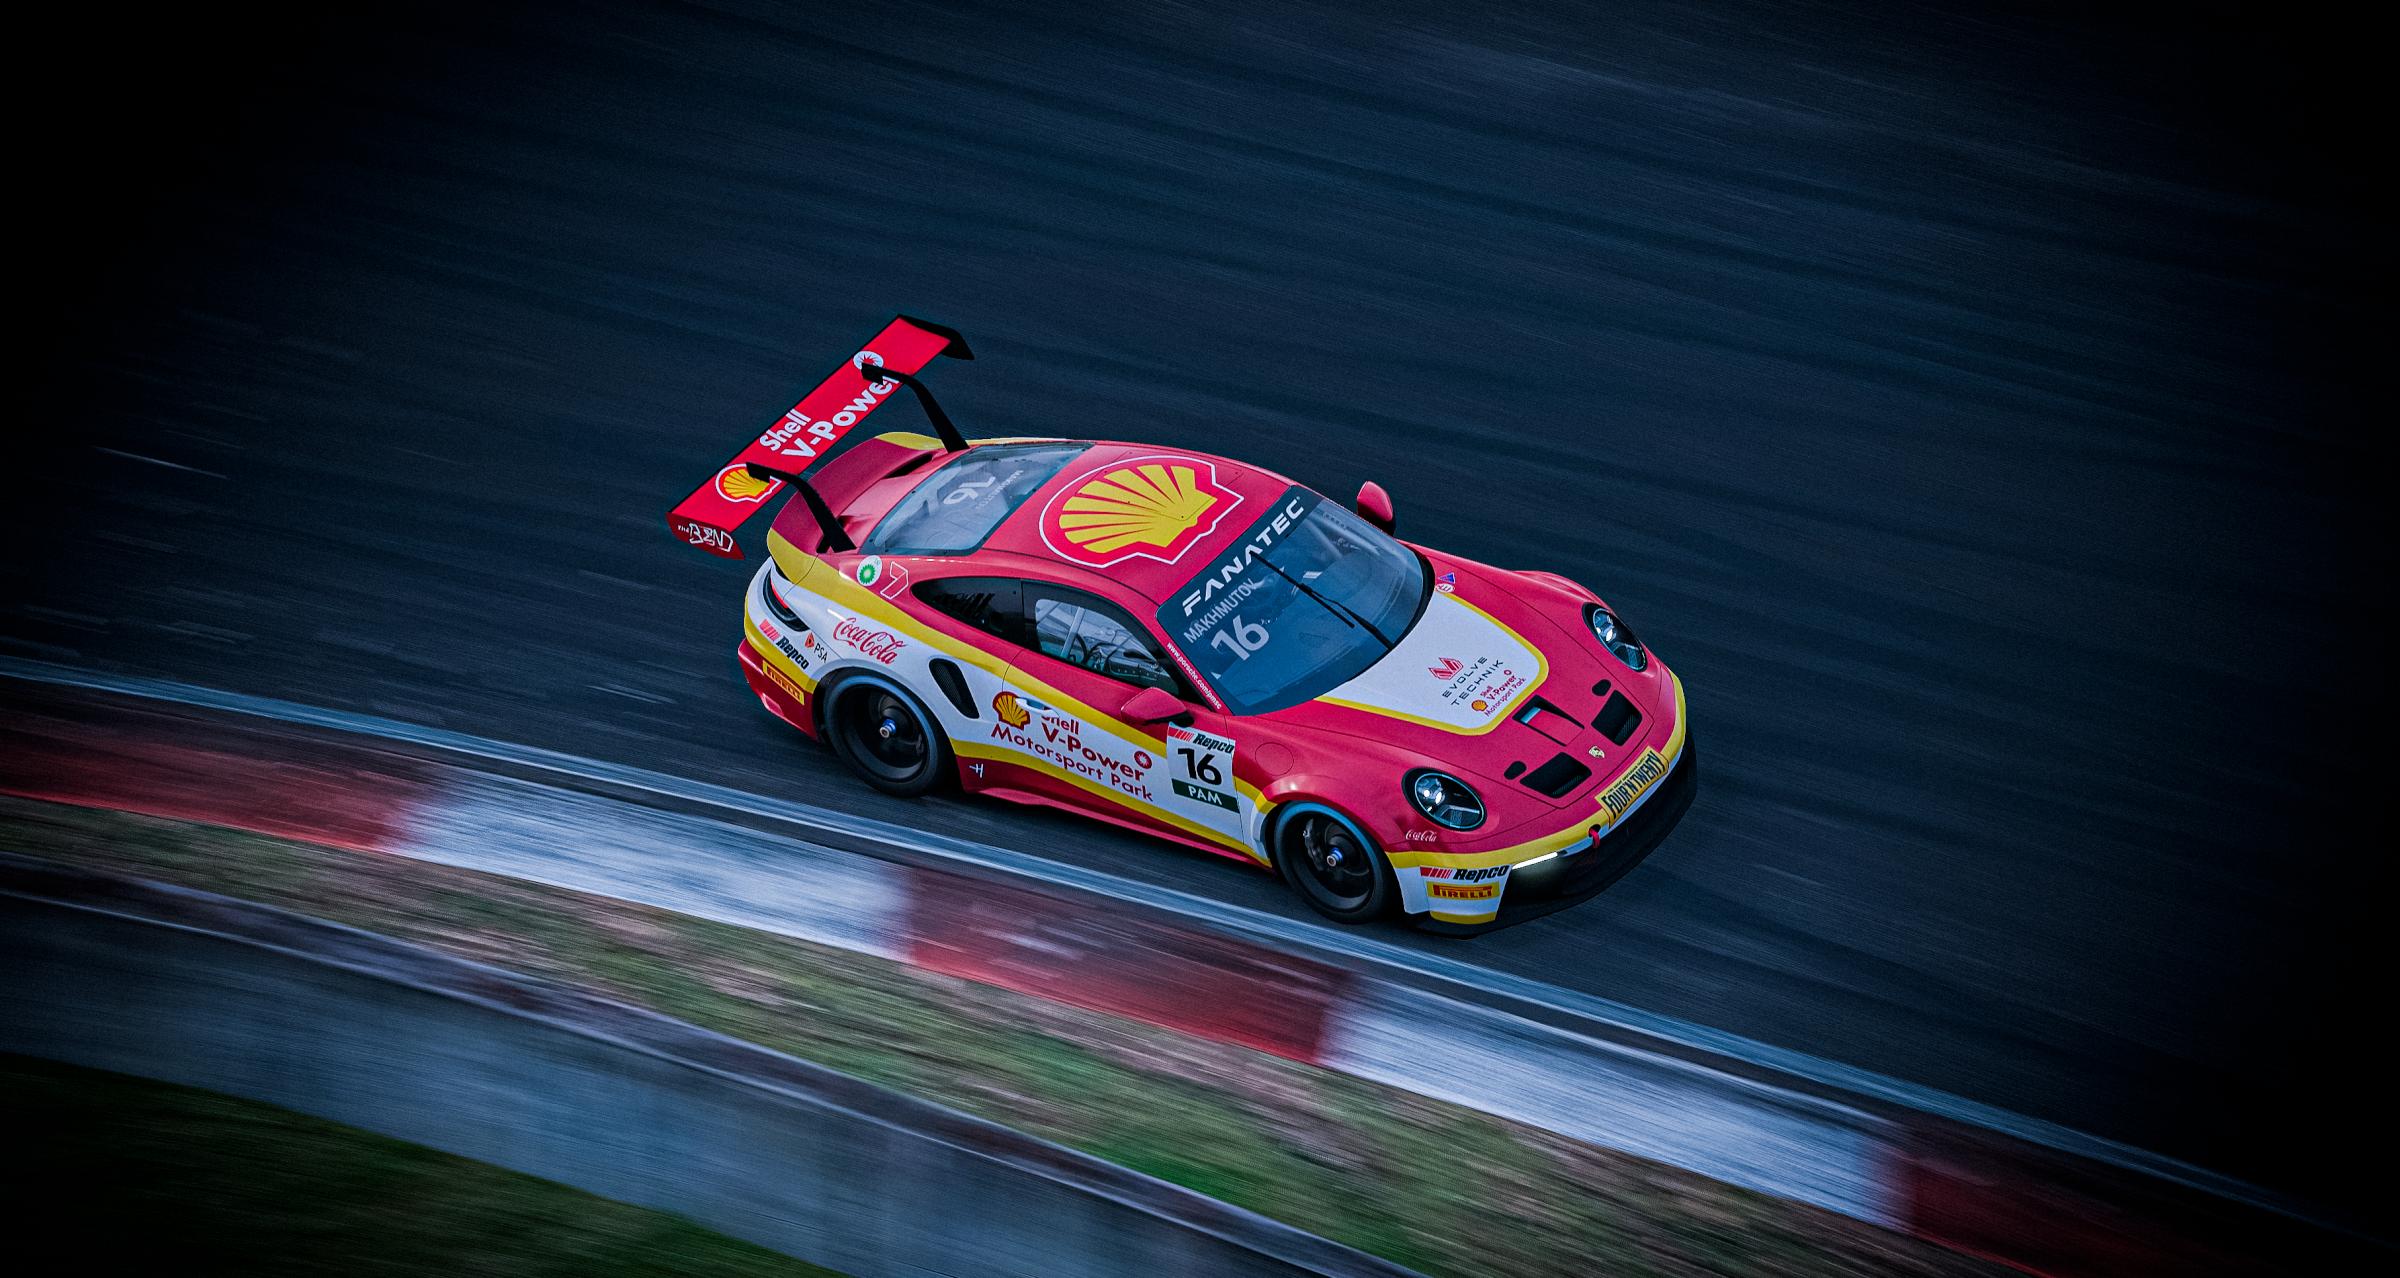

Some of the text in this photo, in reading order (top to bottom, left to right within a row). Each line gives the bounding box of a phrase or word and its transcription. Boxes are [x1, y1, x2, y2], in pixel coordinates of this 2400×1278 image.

[759, 409, 812, 451] Shell
[688, 522, 734, 553] BEND
[1182, 500, 1304, 617] FANATEC
[1183, 577, 1257, 644] MAKHMUTOV
[775, 635, 810, 670] Repco
[813, 642, 828, 664] PSA
[1210, 614, 1270, 661] 16
[1166, 642, 1222, 710] www.porsche.com/pmsc
[1442, 656, 1488, 698] EVOLVE
[1451, 659, 1504, 706] TECHNIK
[991, 723, 1154, 802] Motorsport Park
[1041, 721, 1145, 782] V-Power
[1193, 733, 1236, 754] Repco
[1178, 748, 1223, 786] 16
[1188, 785, 1223, 806] PAM
[1433, 885, 1493, 899] PIRELLI
[1452, 865, 1511, 884] Repco
